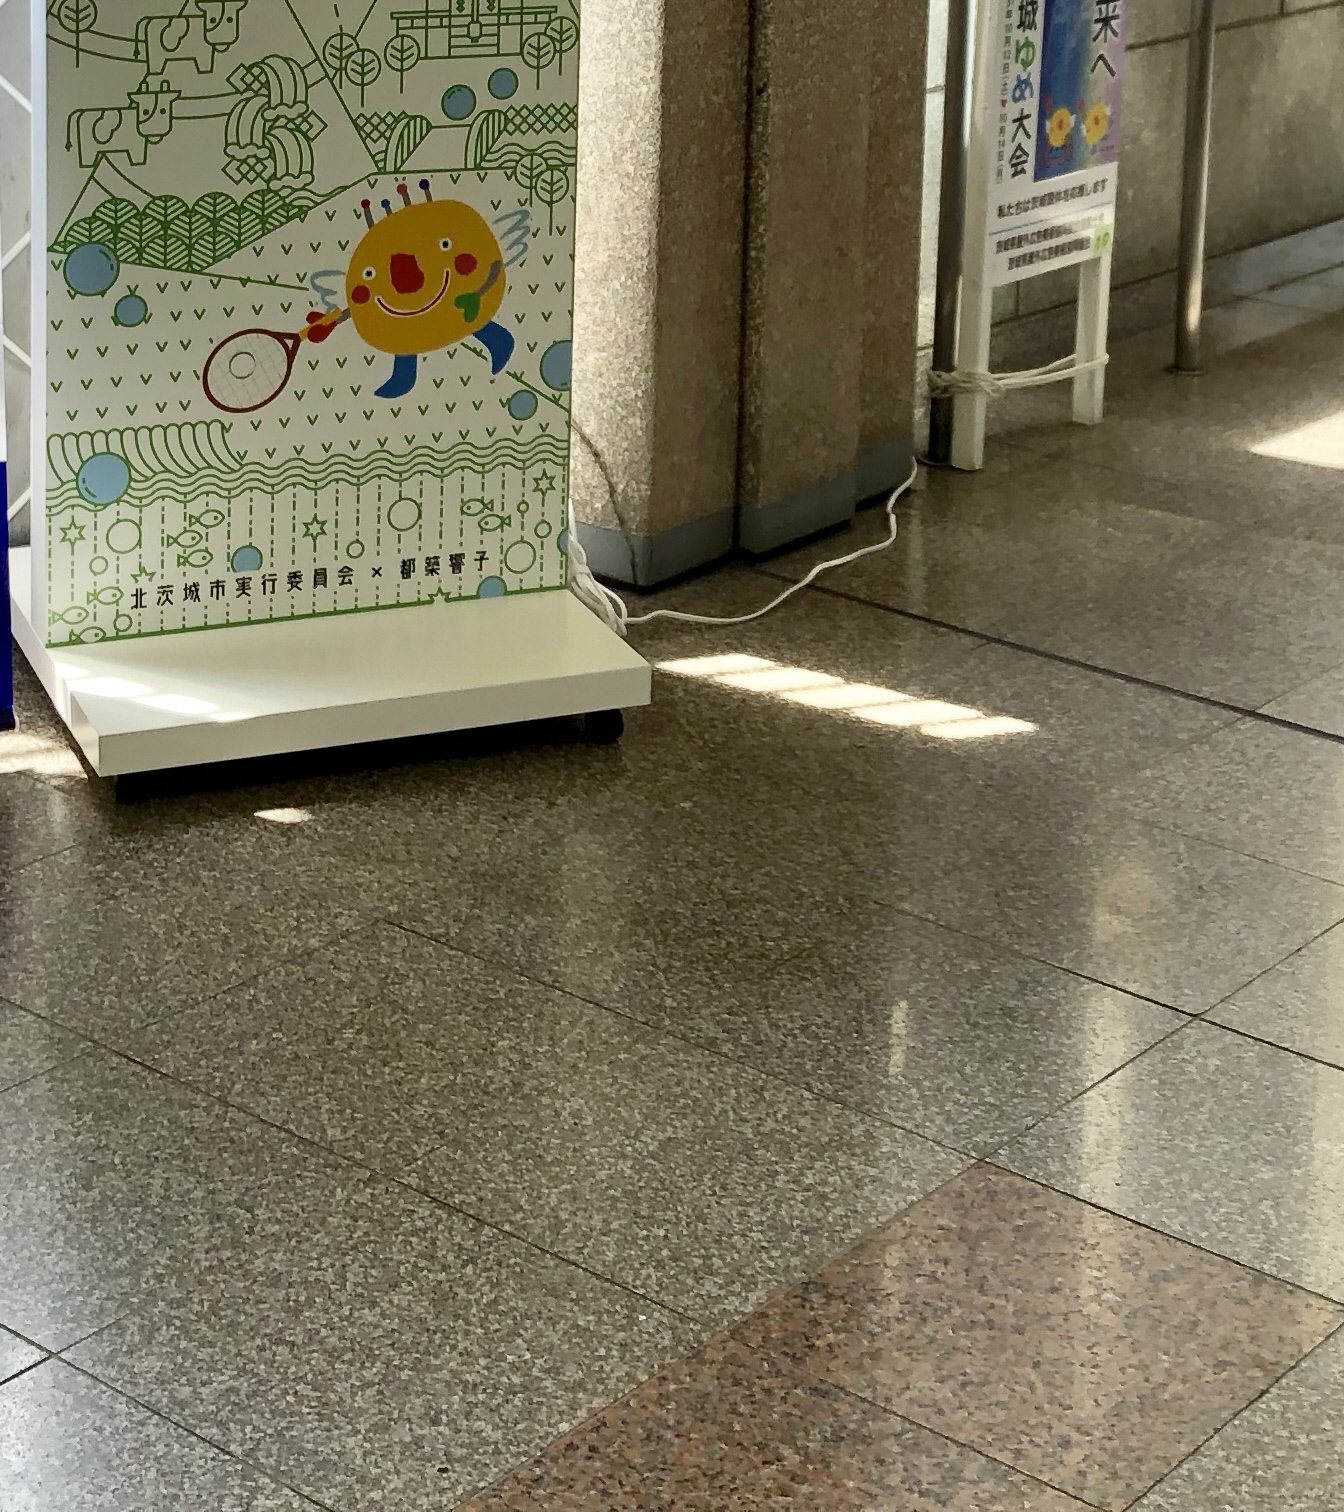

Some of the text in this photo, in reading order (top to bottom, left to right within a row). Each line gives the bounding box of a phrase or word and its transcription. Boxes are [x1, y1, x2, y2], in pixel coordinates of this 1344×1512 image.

[131, 566, 355, 610] 北茨城市実行委員会
